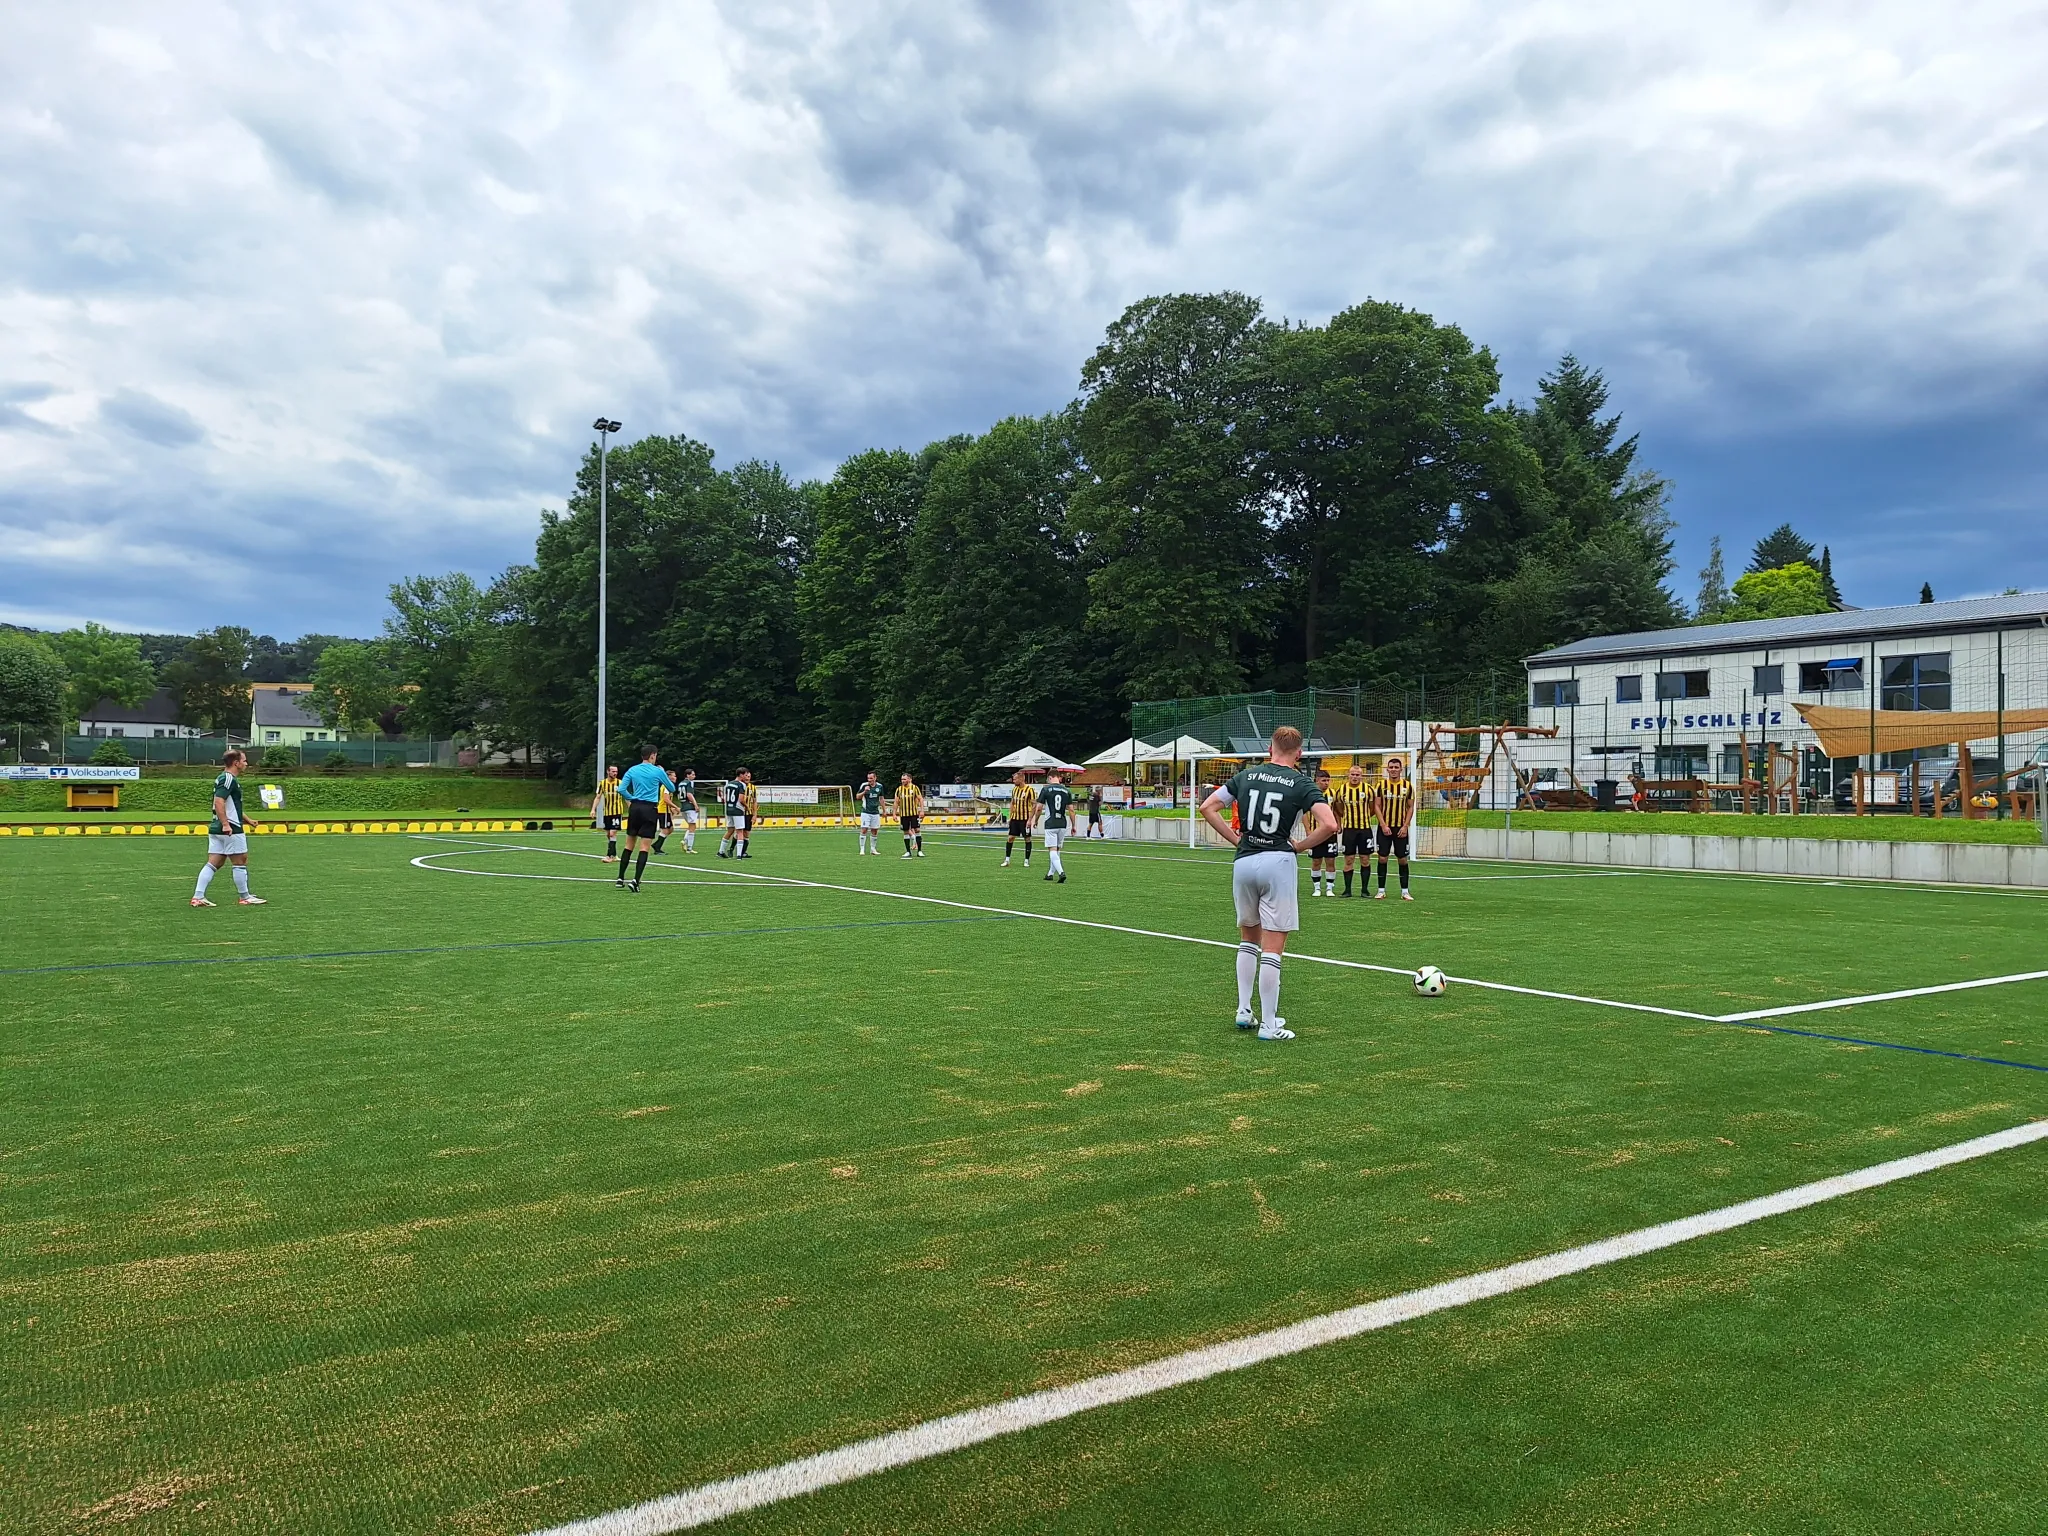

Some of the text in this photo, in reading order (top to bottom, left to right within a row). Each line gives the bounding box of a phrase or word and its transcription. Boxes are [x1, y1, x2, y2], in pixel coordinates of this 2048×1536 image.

[1631, 716, 1667, 730] FSV
[1684, 711, 1782, 728] SCHLEIZ
[70, 768, 137, 776] Volksbank eG
[1247, 772, 1295, 788] SV Mitterteich
[726, 788, 736, 803] 16
[1054, 794, 1062, 811] 8
[1246, 788, 1284, 835] 15
[611, 818, 620, 826] 14
[1327, 842, 1337, 853] 23
